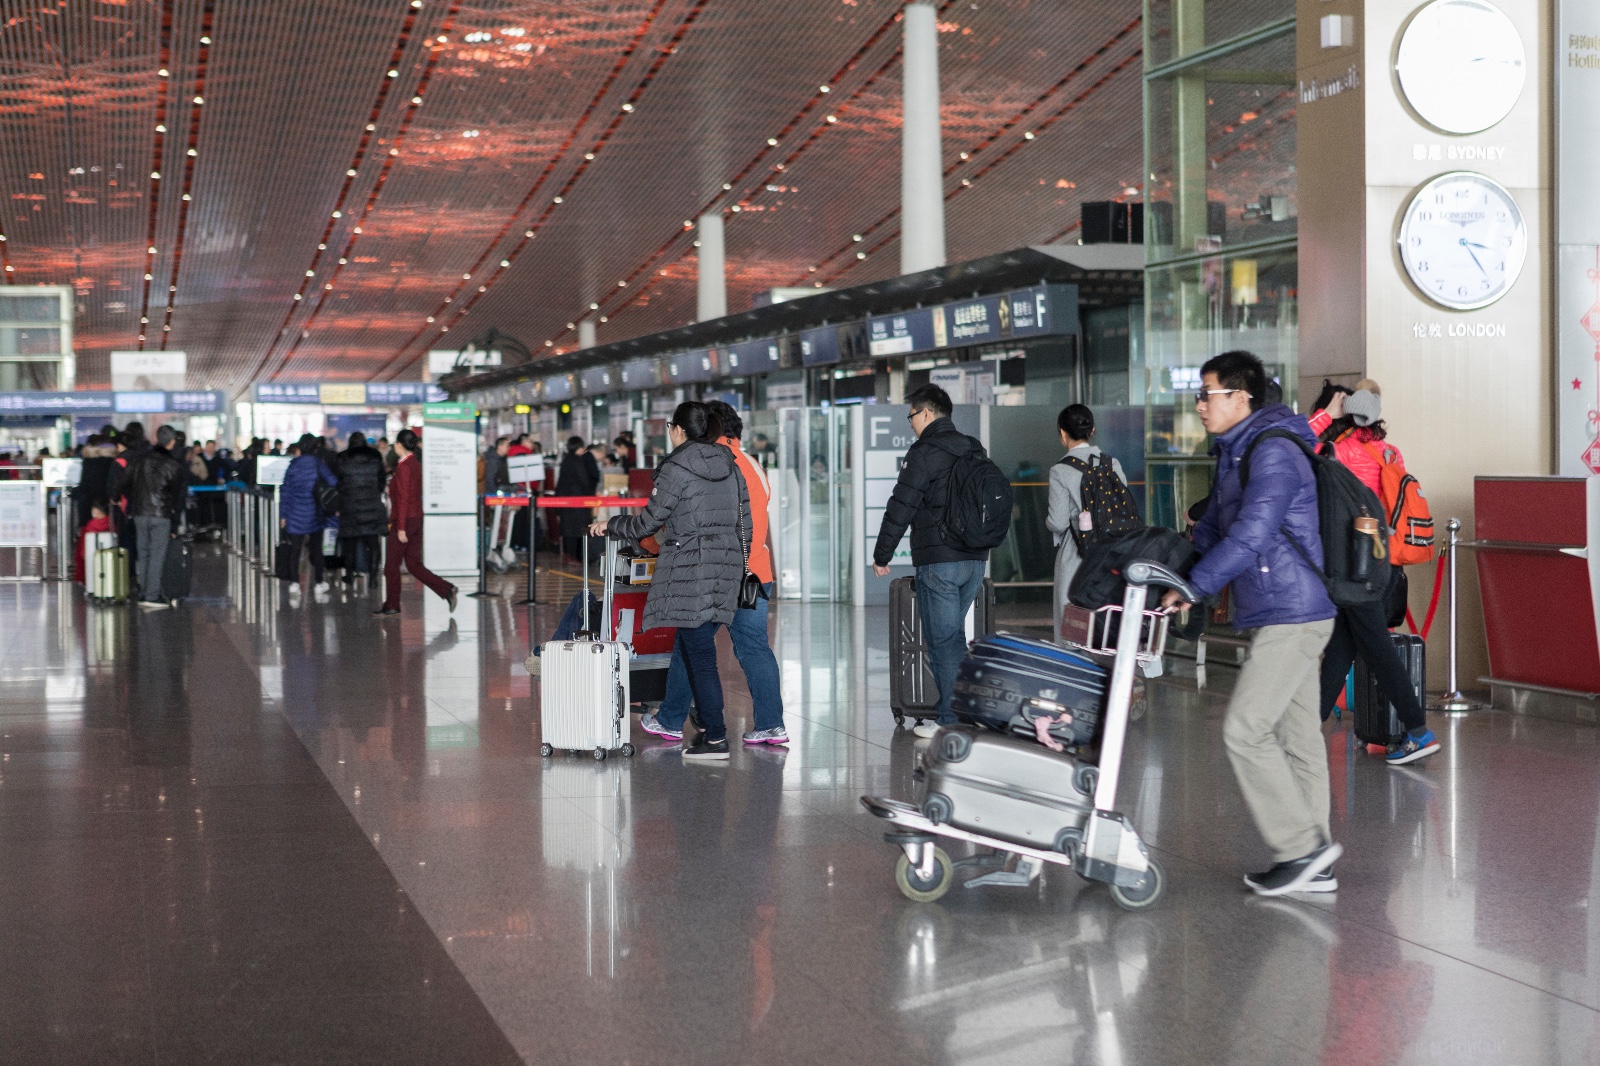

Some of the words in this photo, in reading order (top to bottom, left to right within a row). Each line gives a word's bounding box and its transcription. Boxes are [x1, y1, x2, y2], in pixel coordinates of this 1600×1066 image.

[1447, 145, 1505, 160] SYDNEY
[1419, 211, 1432, 222] 10
[1411, 237, 1421, 247] 9
[1418, 261, 1429, 272] 8
[1435, 280, 1445, 291] 7
[1458, 286, 1467, 296] 6
[1035, 293, 1046, 328] F
[1413, 322, 1441, 338] 伦敦
[1448, 323, 1505, 337] LONDON
[870, 417, 892, 447] F
